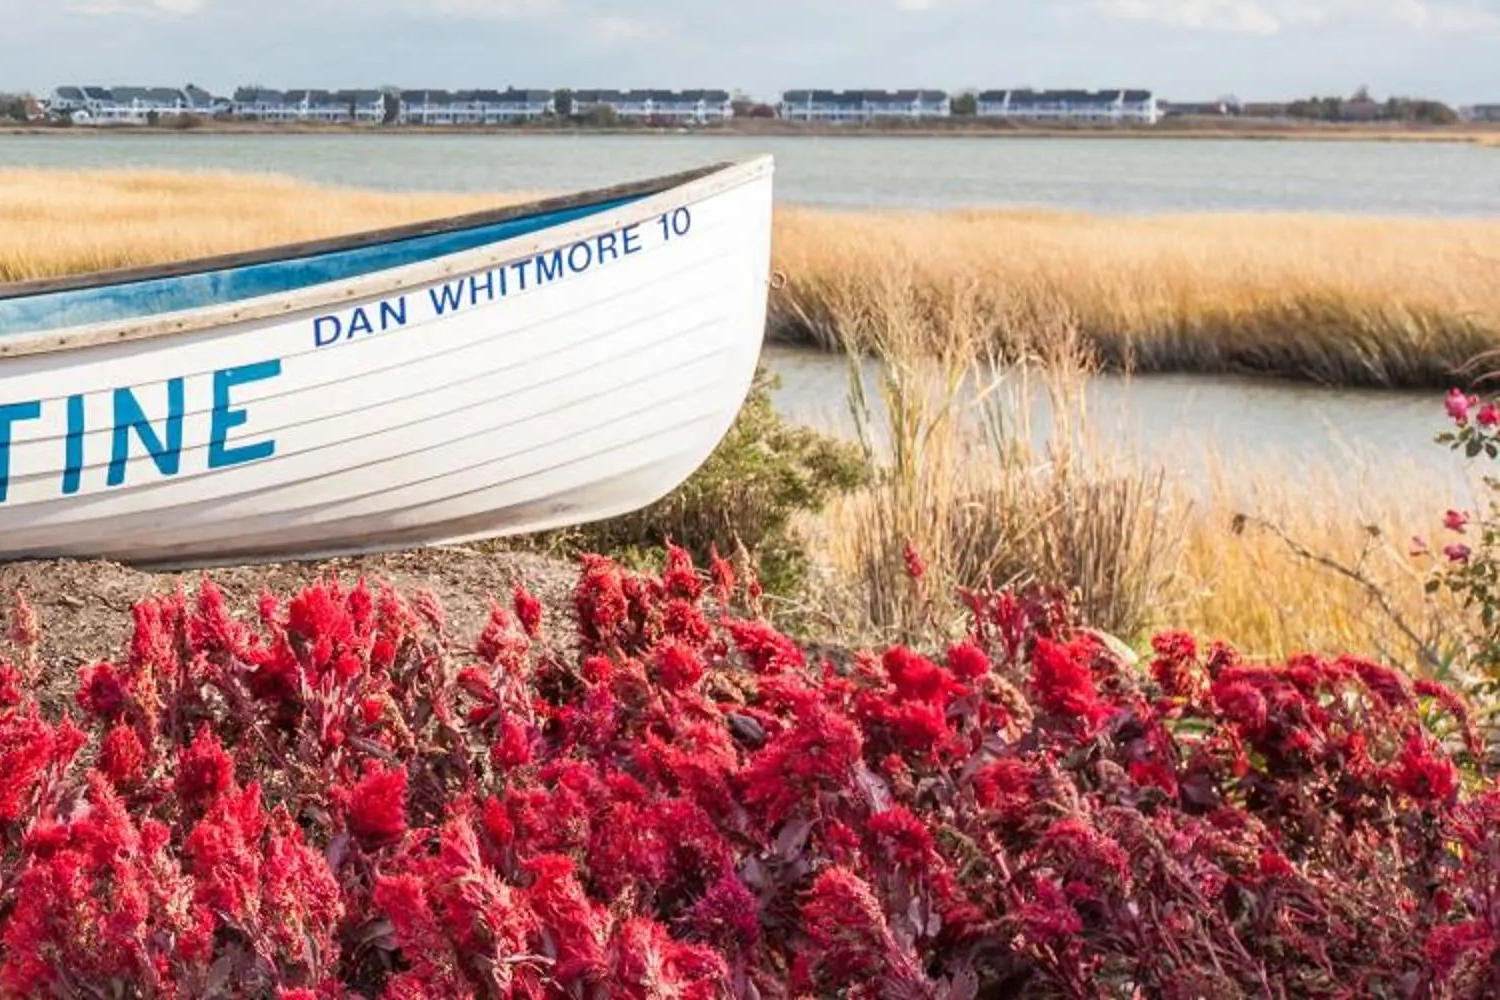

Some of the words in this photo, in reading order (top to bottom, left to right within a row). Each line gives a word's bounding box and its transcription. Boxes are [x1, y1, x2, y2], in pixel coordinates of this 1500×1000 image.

[313, 296, 407, 347] DAN
[430, 222, 642, 315] WHITMORE
[657, 206, 692, 241] 10
